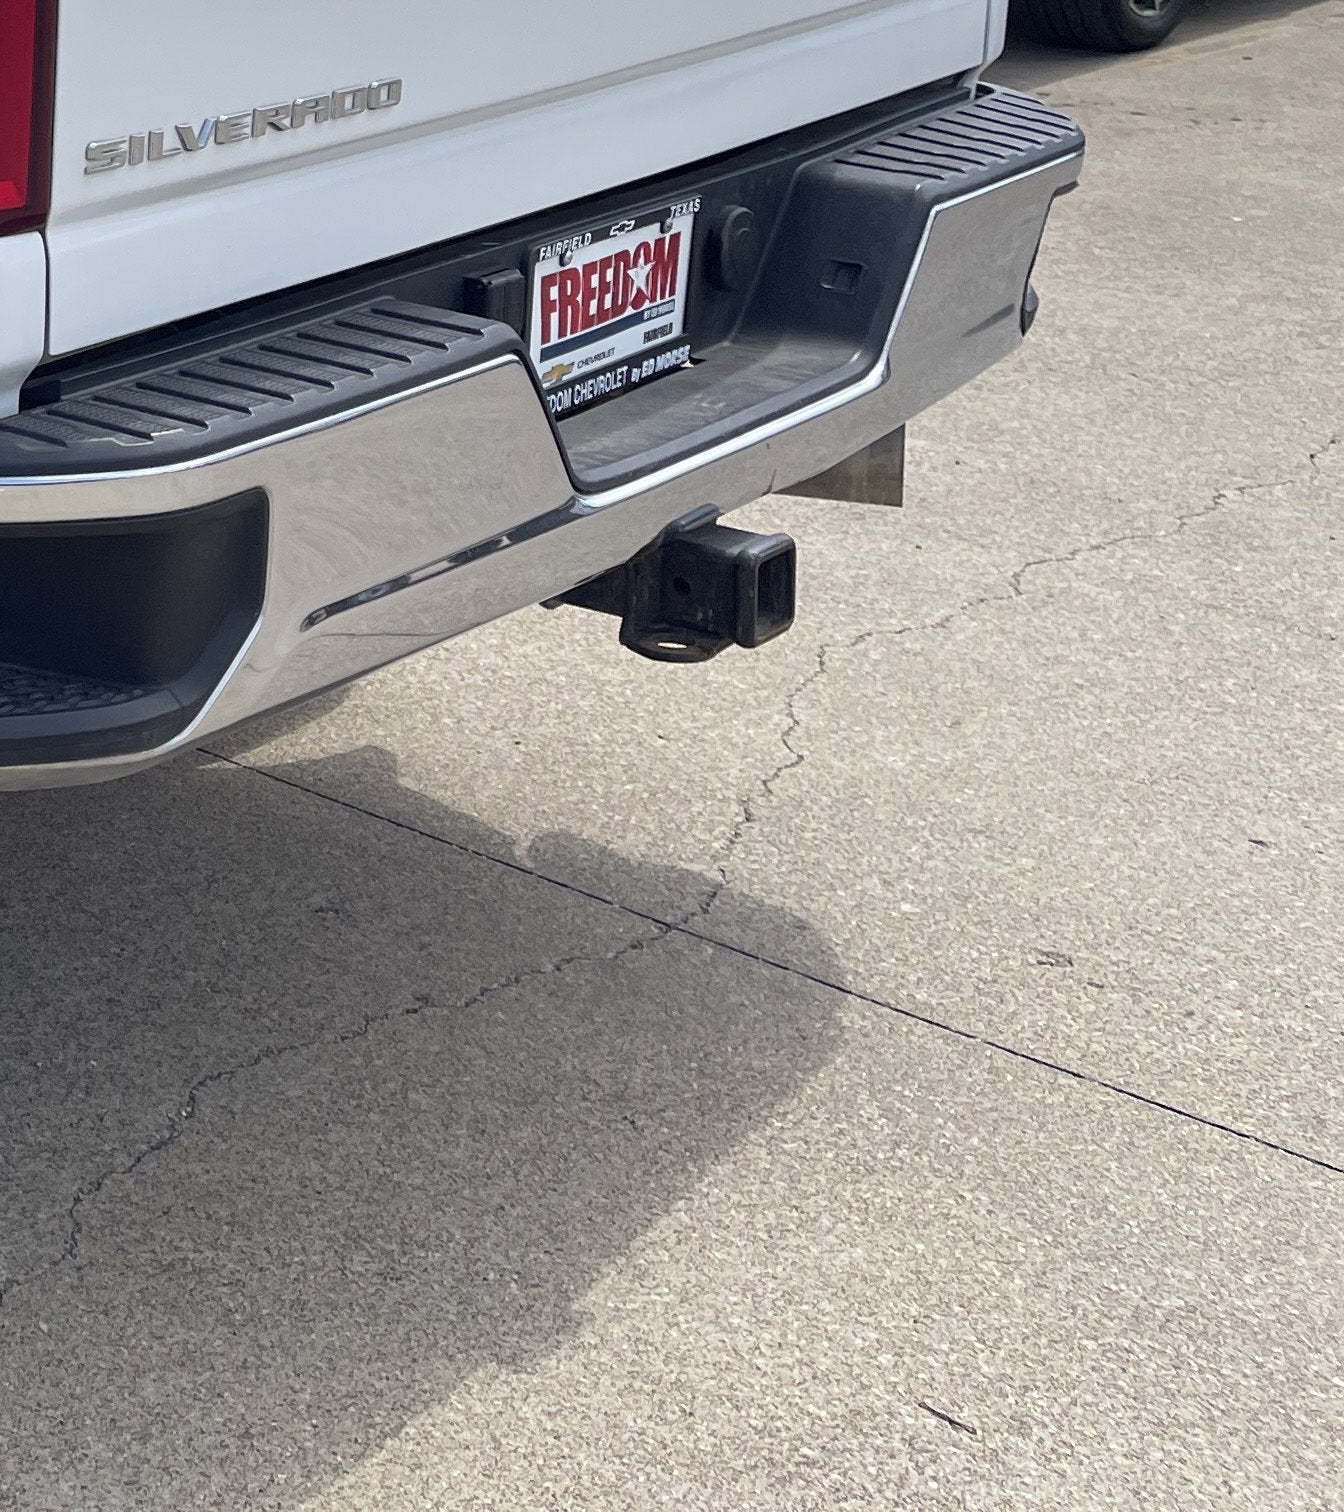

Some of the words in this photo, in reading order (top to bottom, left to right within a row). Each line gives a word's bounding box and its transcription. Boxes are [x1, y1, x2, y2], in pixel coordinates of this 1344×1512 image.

[83, 78, 403, 176] SILVERADO
[539, 232, 593, 261] FAIRFIELD
[670, 198, 701, 219] TEXAS
[540, 231, 682, 346] FREEDOM
[574, 366, 629, 405] CHEVROLET
[641, 358, 655, 378] ED
